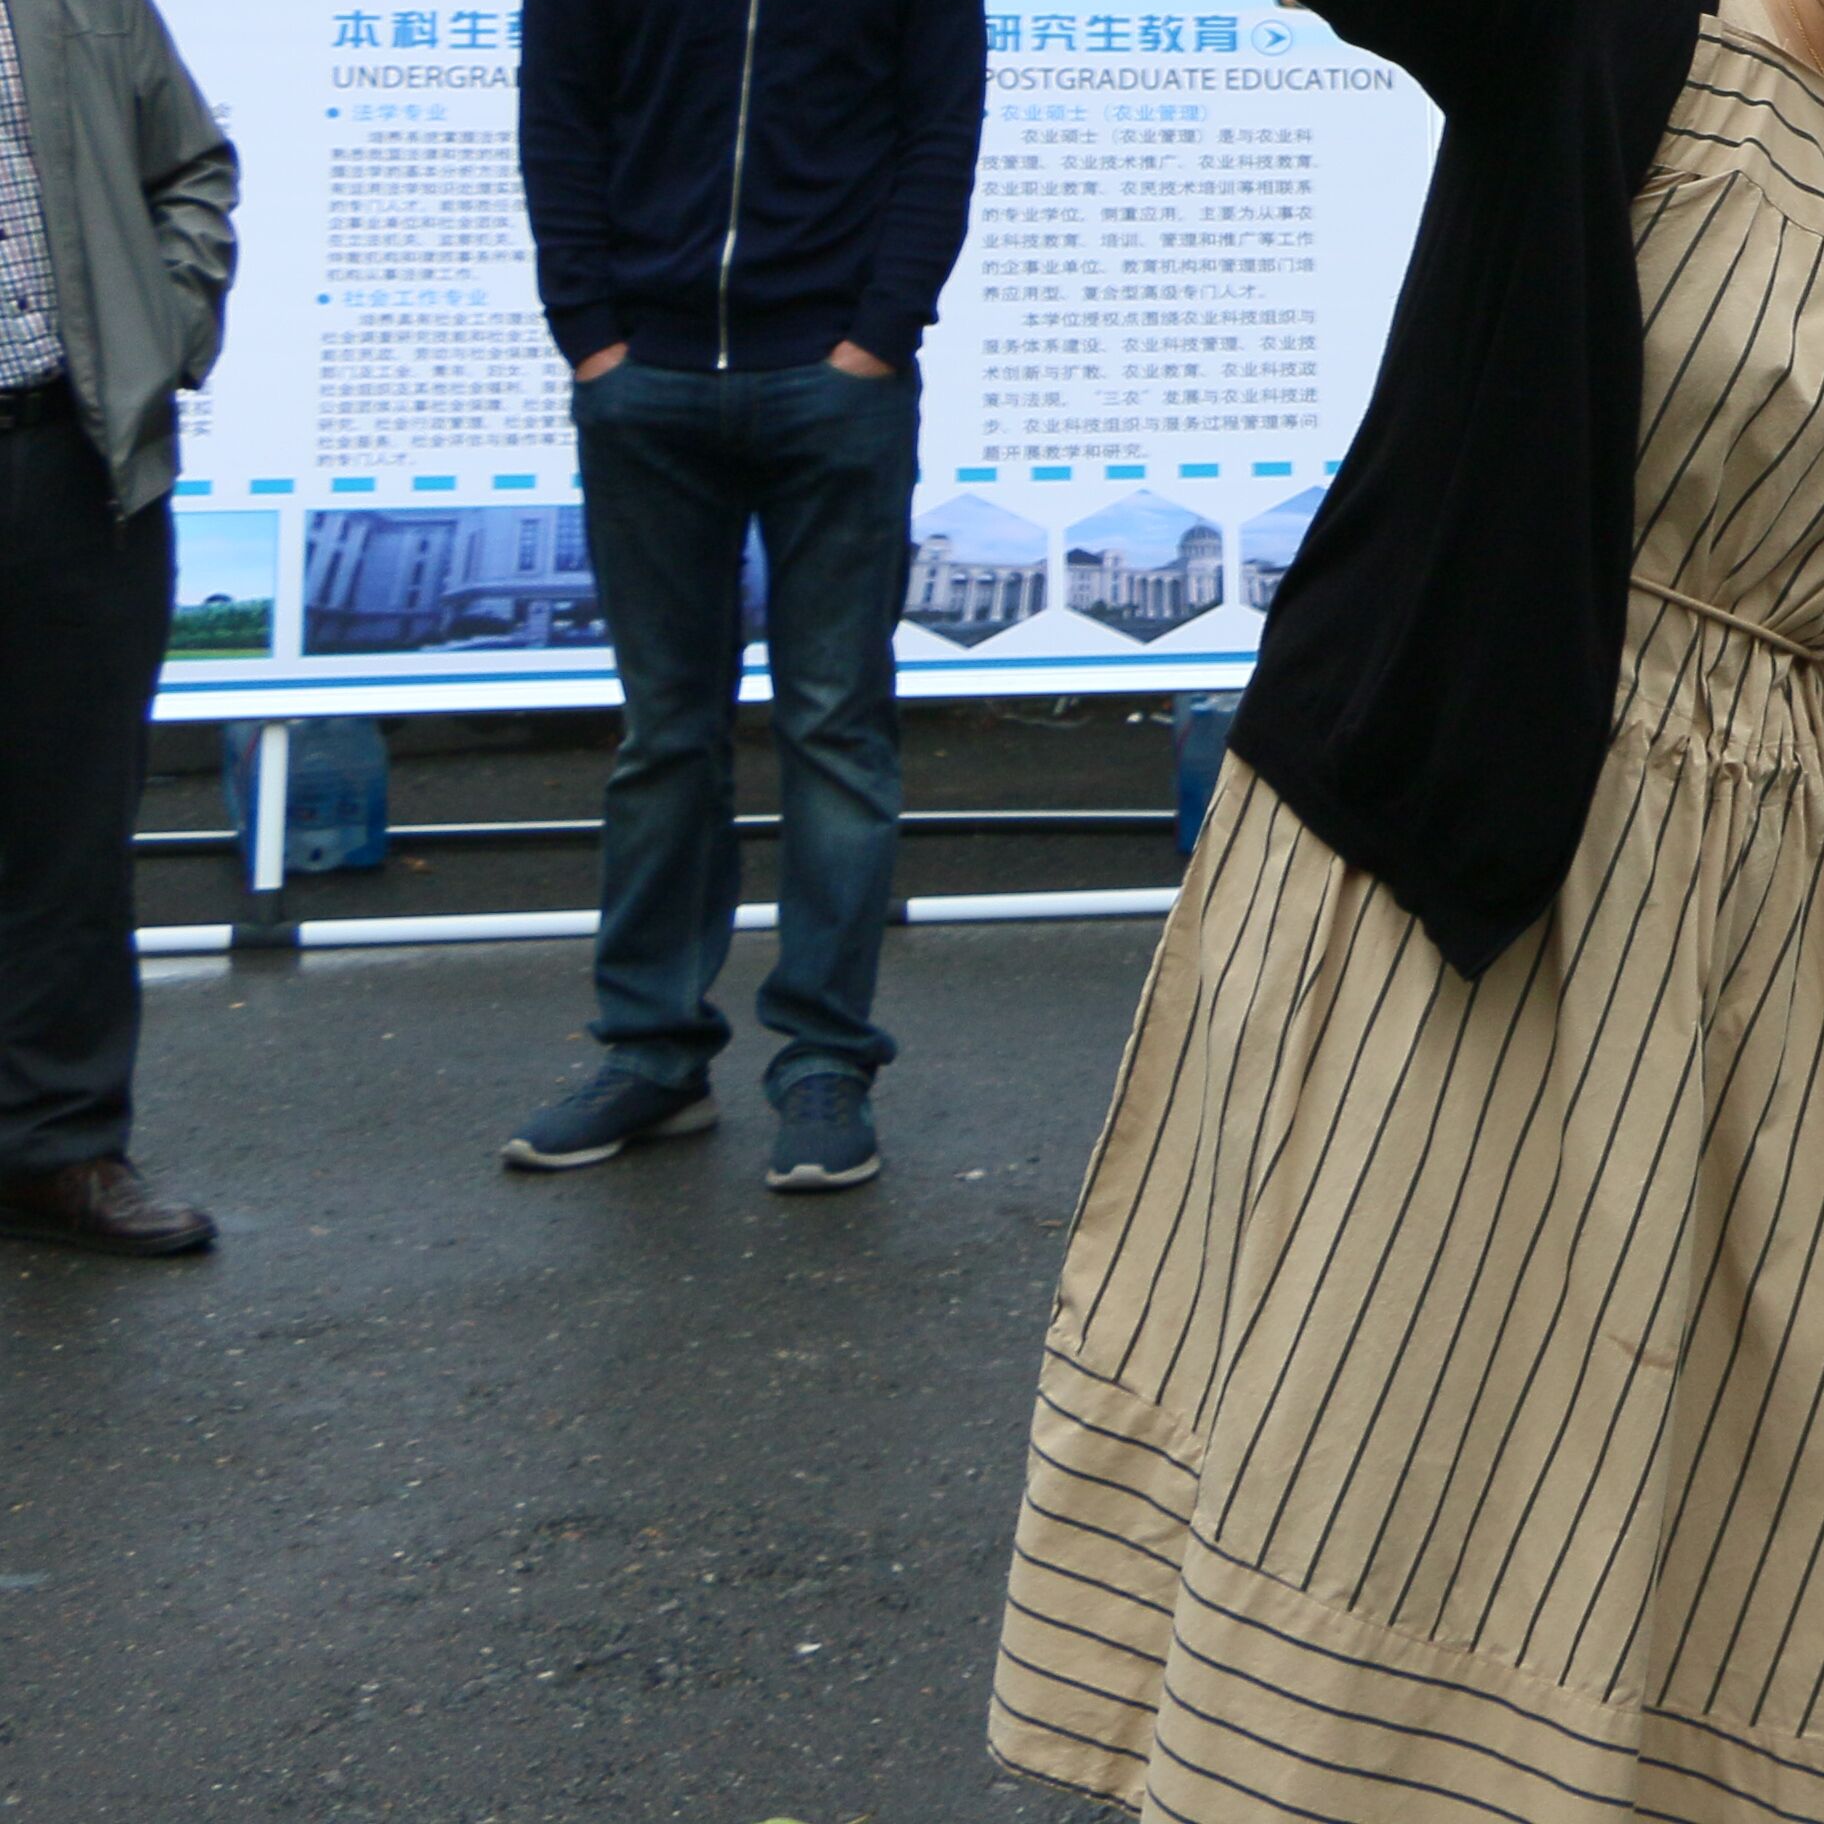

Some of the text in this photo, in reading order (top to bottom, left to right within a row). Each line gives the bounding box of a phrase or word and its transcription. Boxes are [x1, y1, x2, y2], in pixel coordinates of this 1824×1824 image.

[985, 14, 1239, 53] 研究生教育
[333, 65, 520, 89] UNDERGRA
[985, 67, 1394, 92] POSTGRADUATE EDUCATION
